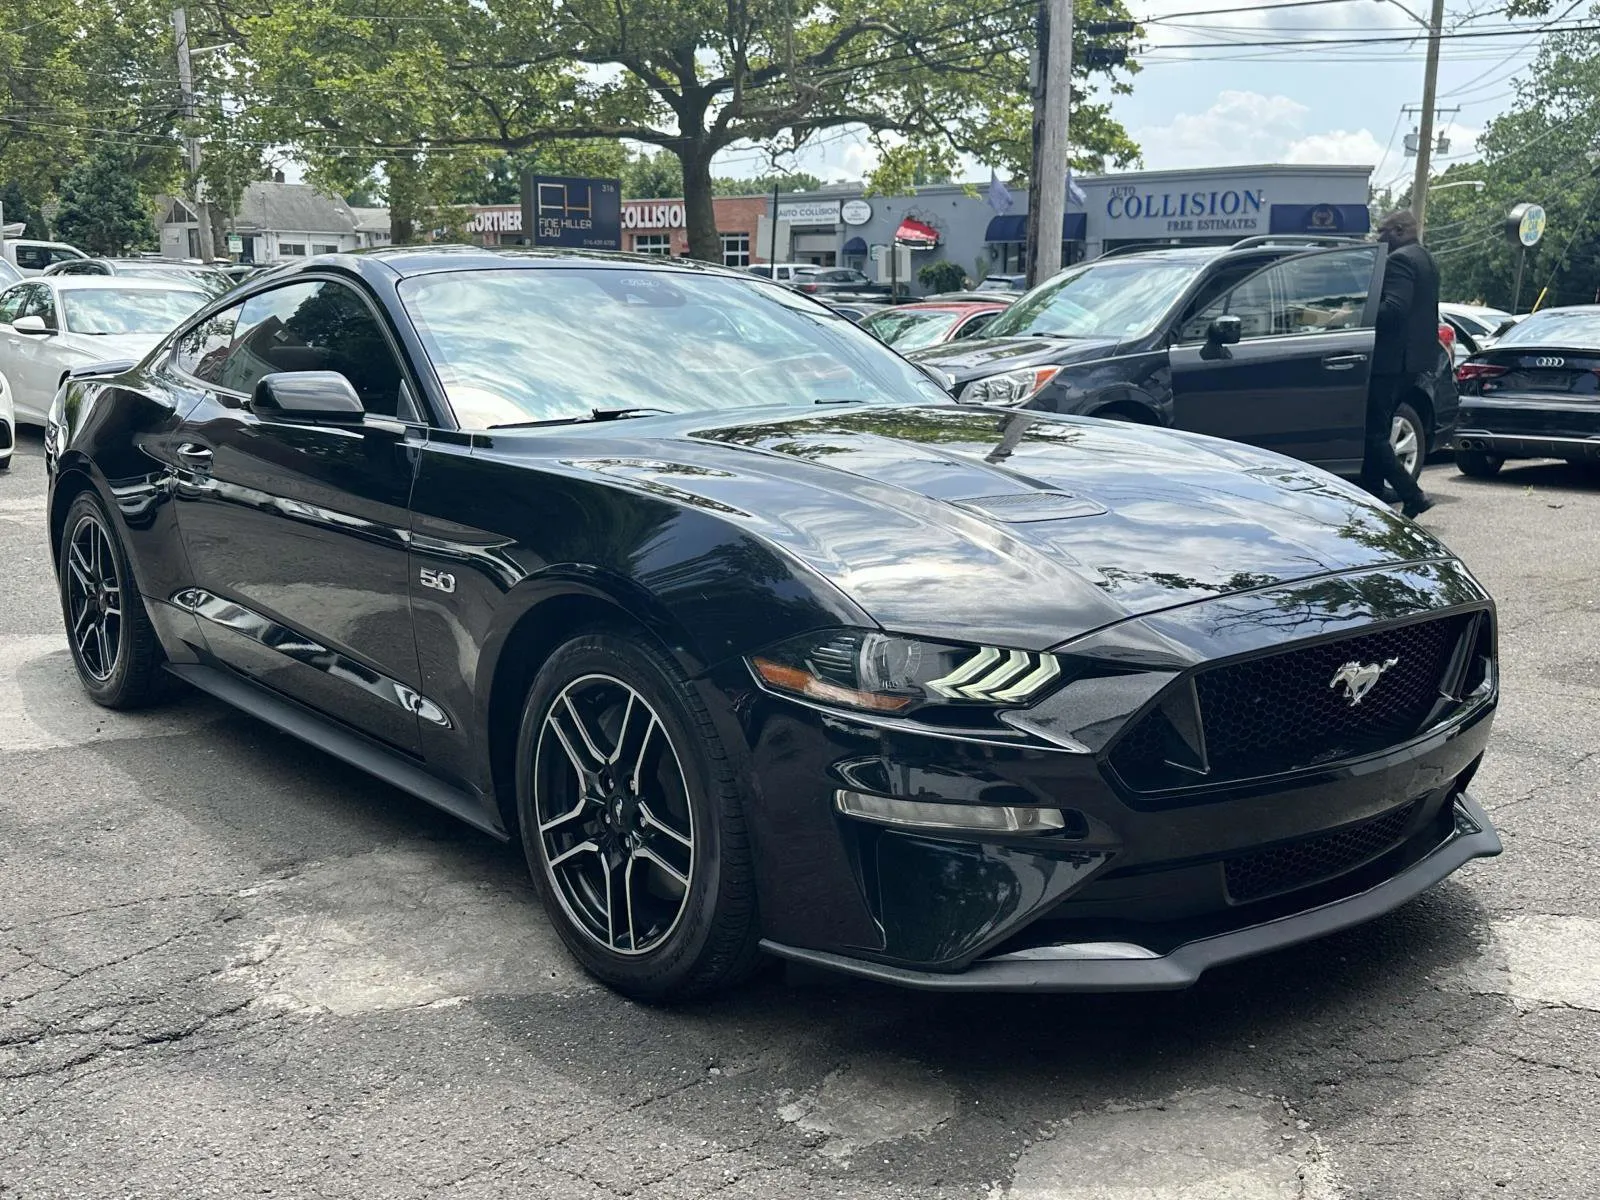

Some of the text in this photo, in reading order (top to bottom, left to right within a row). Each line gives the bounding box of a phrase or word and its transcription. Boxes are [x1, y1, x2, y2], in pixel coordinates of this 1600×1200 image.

[1109, 186, 1136, 197] AUTO
[1107, 189, 1264, 219] COLLISION
[778, 209, 798, 217] AUTO
[800, 207, 839, 217] COLLISION
[539, 217, 592, 229] FINE HILLER
[1167, 218, 1257, 232] FREE ESTIMATES
[539, 228, 561, 238] LAW
